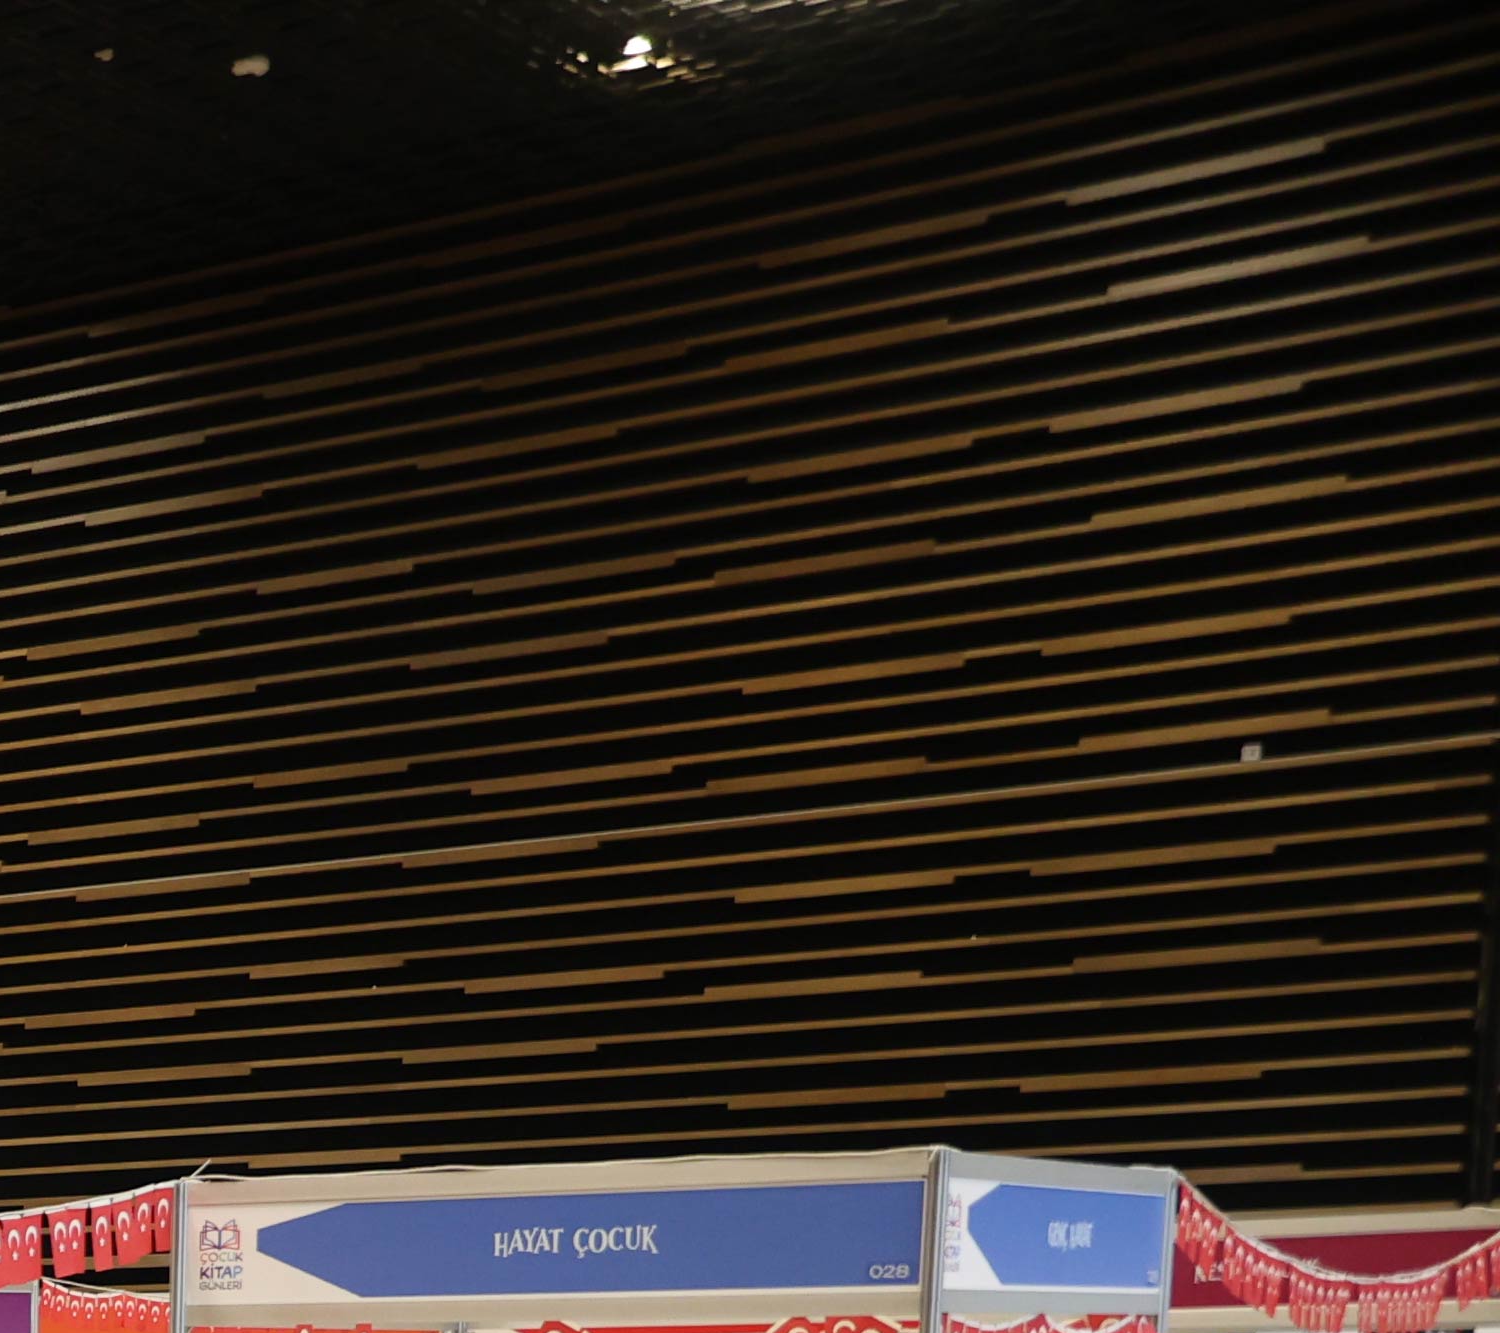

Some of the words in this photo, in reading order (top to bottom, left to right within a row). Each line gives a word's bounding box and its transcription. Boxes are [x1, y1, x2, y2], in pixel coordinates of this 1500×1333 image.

[494, 1226, 563, 1257] HAYAT
[573, 1224, 658, 1259] ÇOCUK
[200, 1252, 243, 1266] ÇOCUK
[199, 1264, 243, 1281] KİTAP
[869, 1262, 910, 1280] 028
[200, 1279, 242, 1291] GÜNLERİ
